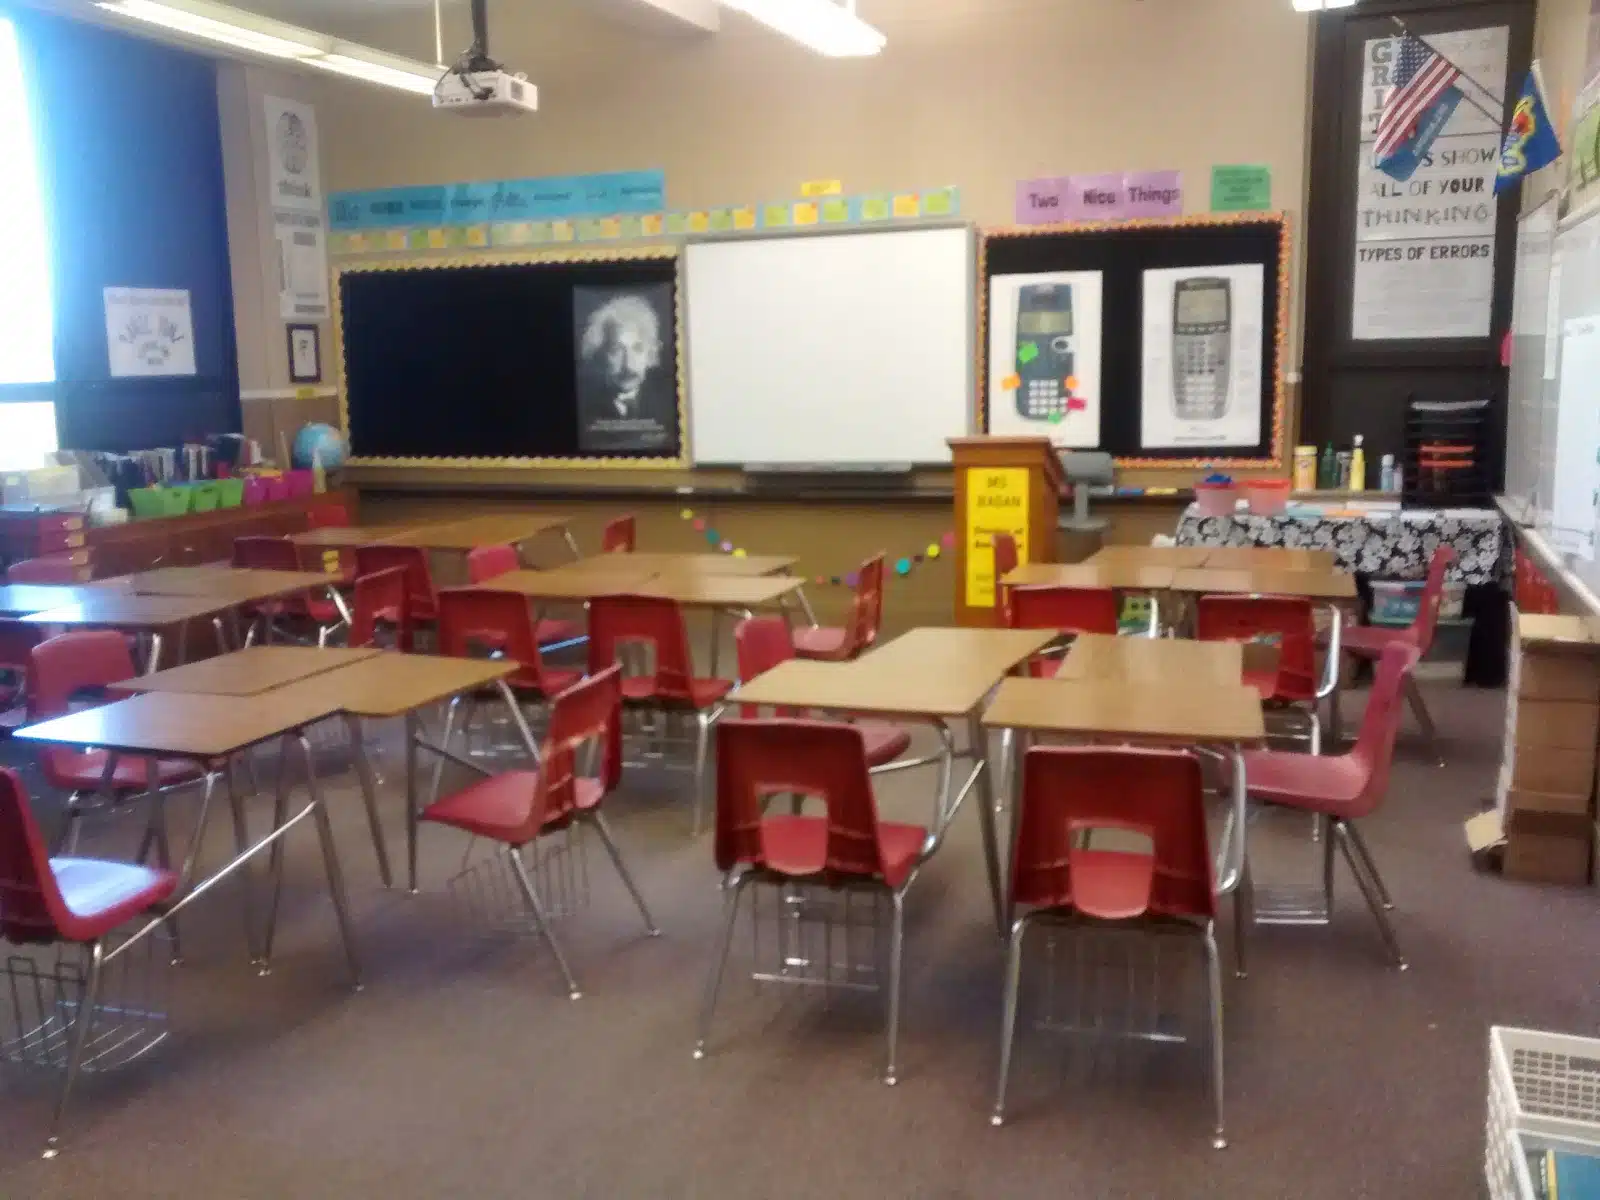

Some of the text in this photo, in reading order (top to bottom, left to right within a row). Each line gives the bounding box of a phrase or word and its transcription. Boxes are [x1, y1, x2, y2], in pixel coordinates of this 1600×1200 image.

[1441, 147, 1497, 166] SHOW
[1029, 185, 1181, 208] Two Nice Things
[1371, 177, 1485, 198] ALL OF YOUR
[1362, 203, 1489, 228] THINKING
[1359, 244, 1491, 263] TYPES OF ERRORS
